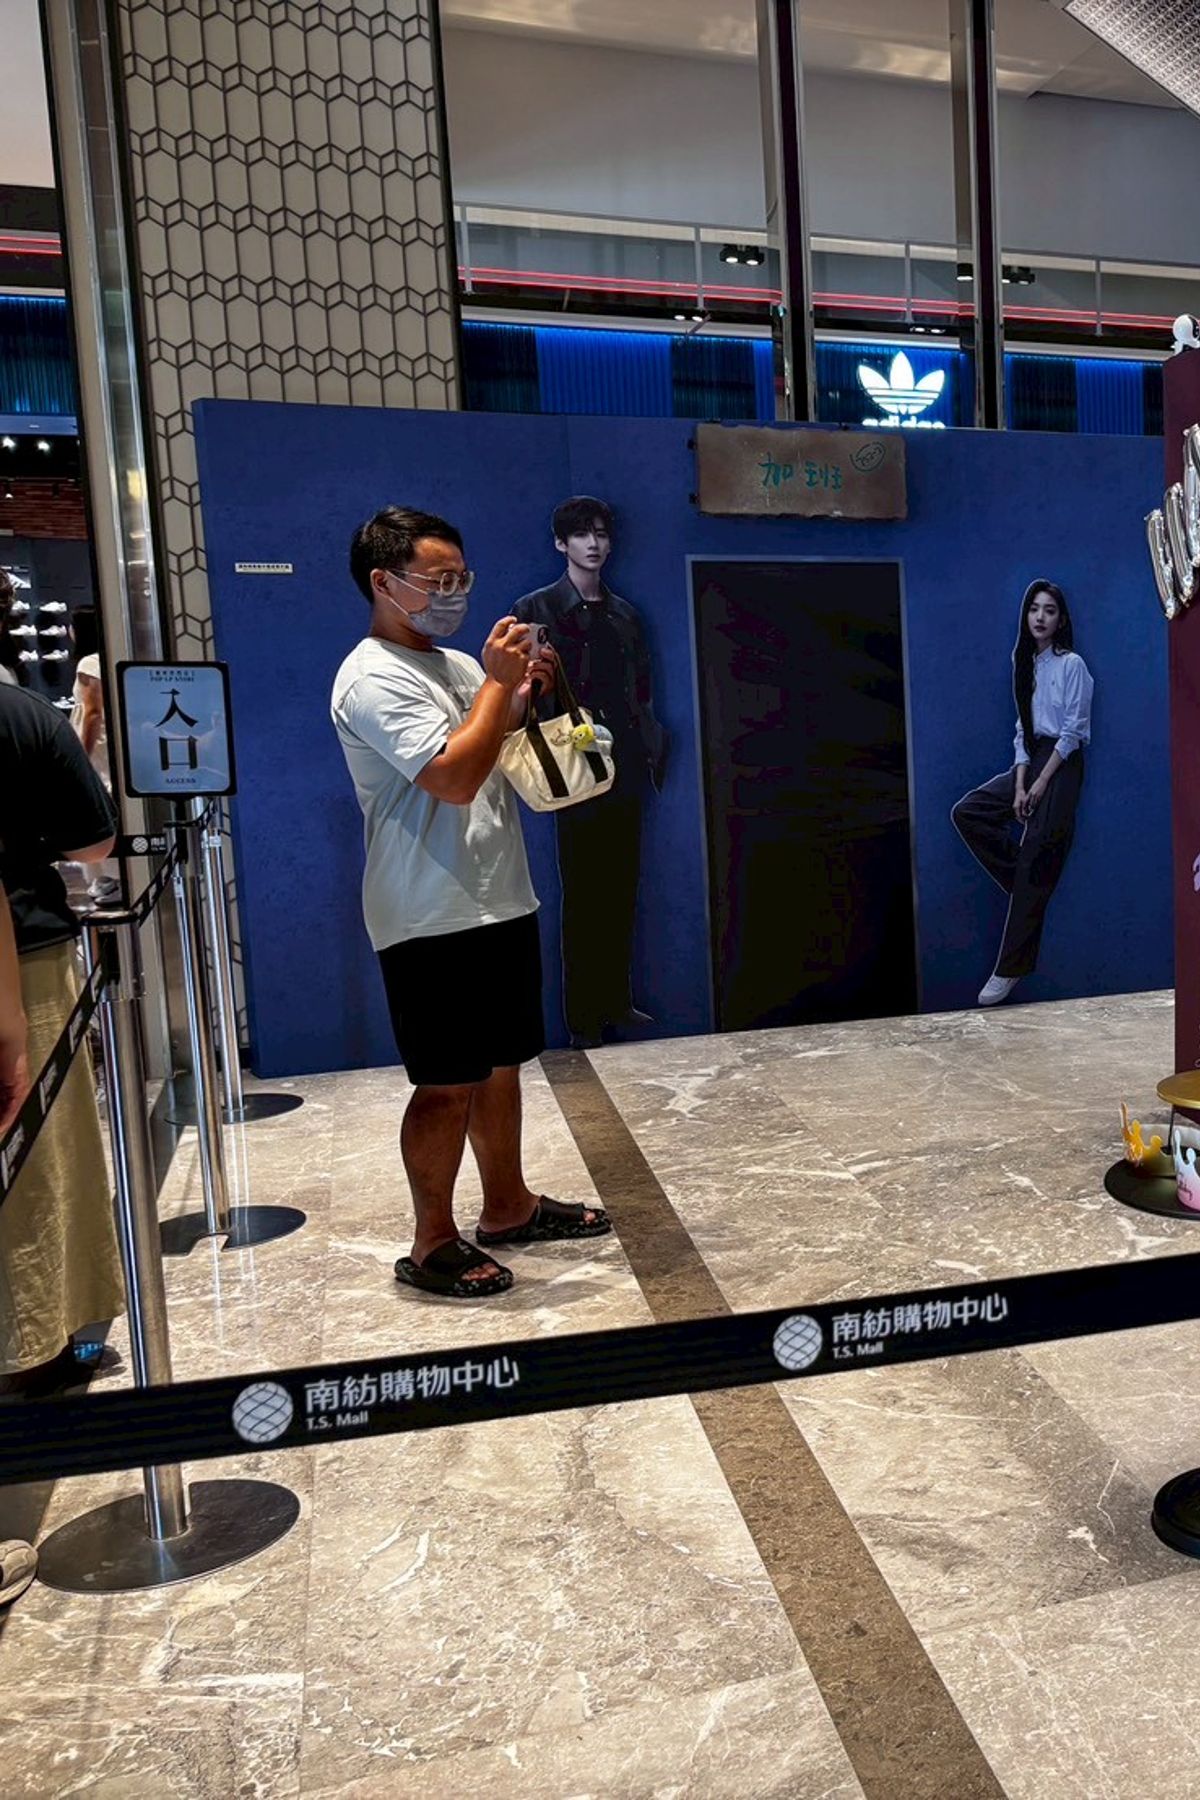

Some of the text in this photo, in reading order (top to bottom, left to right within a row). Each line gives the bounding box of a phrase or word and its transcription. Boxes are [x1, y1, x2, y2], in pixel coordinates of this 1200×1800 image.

[154, 688, 199, 771] 入口
[831, 1293, 1008, 1343] 南紡購物中心
[832, 1342, 884, 1359] T.S. Mall
[304, 1356, 520, 1413] 南紡購物中心
[305, 1412, 369, 1431] T.S. Mall
